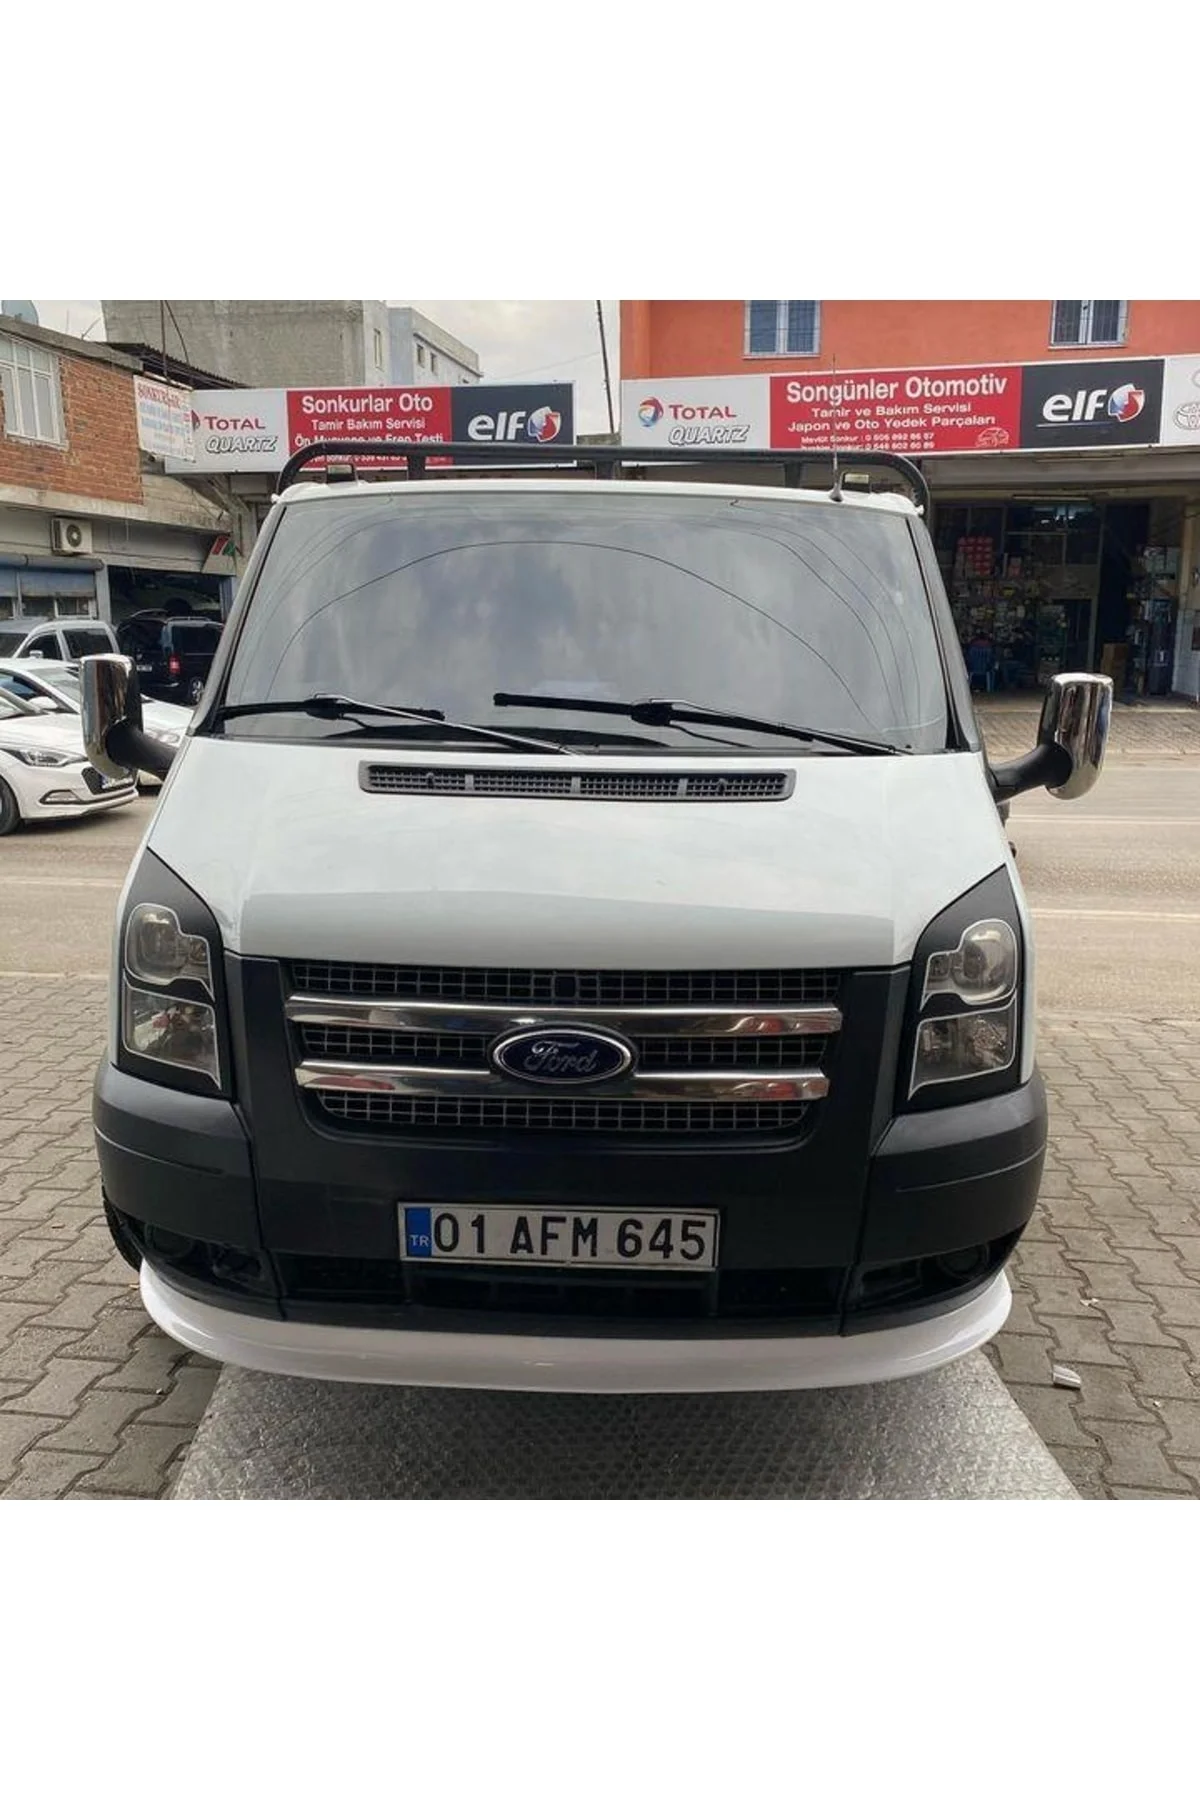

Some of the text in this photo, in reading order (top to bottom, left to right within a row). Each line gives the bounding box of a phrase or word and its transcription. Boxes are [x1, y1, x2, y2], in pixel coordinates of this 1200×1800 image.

[787, 373, 1008, 406] Songünler Otomotiv
[302, 393, 433, 414] Sonkurlar Oto
[668, 404, 737, 420] TOTAL
[812, 402, 972, 418] Tamir ve Bakım Servisi
[1042, 389, 1108, 422] elf
[204, 416, 266, 431] TOTAL
[312, 416, 426, 431] Tamir Bakım Servisi
[467, 411, 527, 441] elf
[787, 415, 996, 433] Japon ve Oto Yedek Parçaları
[205, 435, 278, 453] QUARTZ
[668, 425, 750, 446] QUARTZ
[523, 1040, 599, 1072] Ford
[410, 1233, 430, 1247] TR
[434, 1213, 707, 1261] 01 AFM 645
